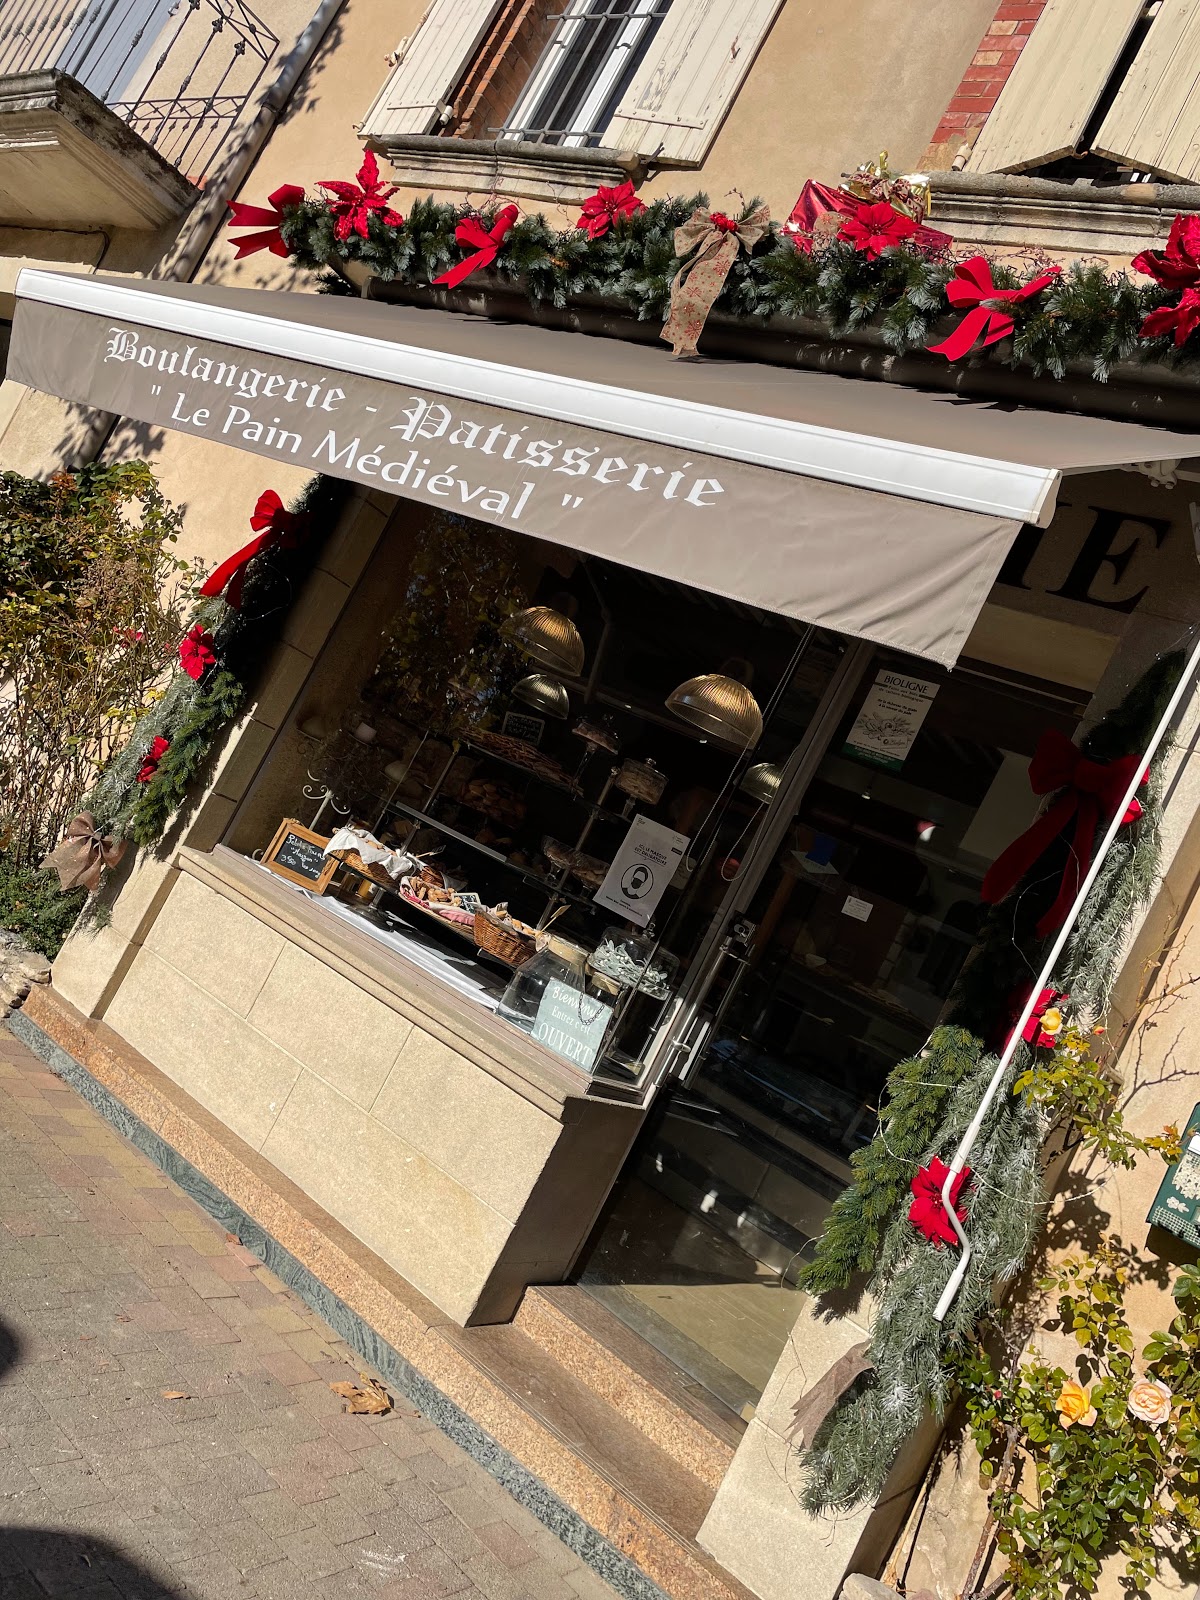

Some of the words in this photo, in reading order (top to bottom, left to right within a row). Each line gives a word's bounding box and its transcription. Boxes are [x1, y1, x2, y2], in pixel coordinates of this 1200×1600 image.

[103, 327, 347, 413] Boulangerie
[389, 396, 725, 507] Patisserie
[171, 393, 206, 428] Le
[221, 404, 302, 454] Pain
[312, 429, 535, 519] Médiéval
[883, 675, 929, 694] BIOLIGNE
[551, 1005, 575, 1026] Entrez
[538, 1022, 593, 1065] OUVERT
